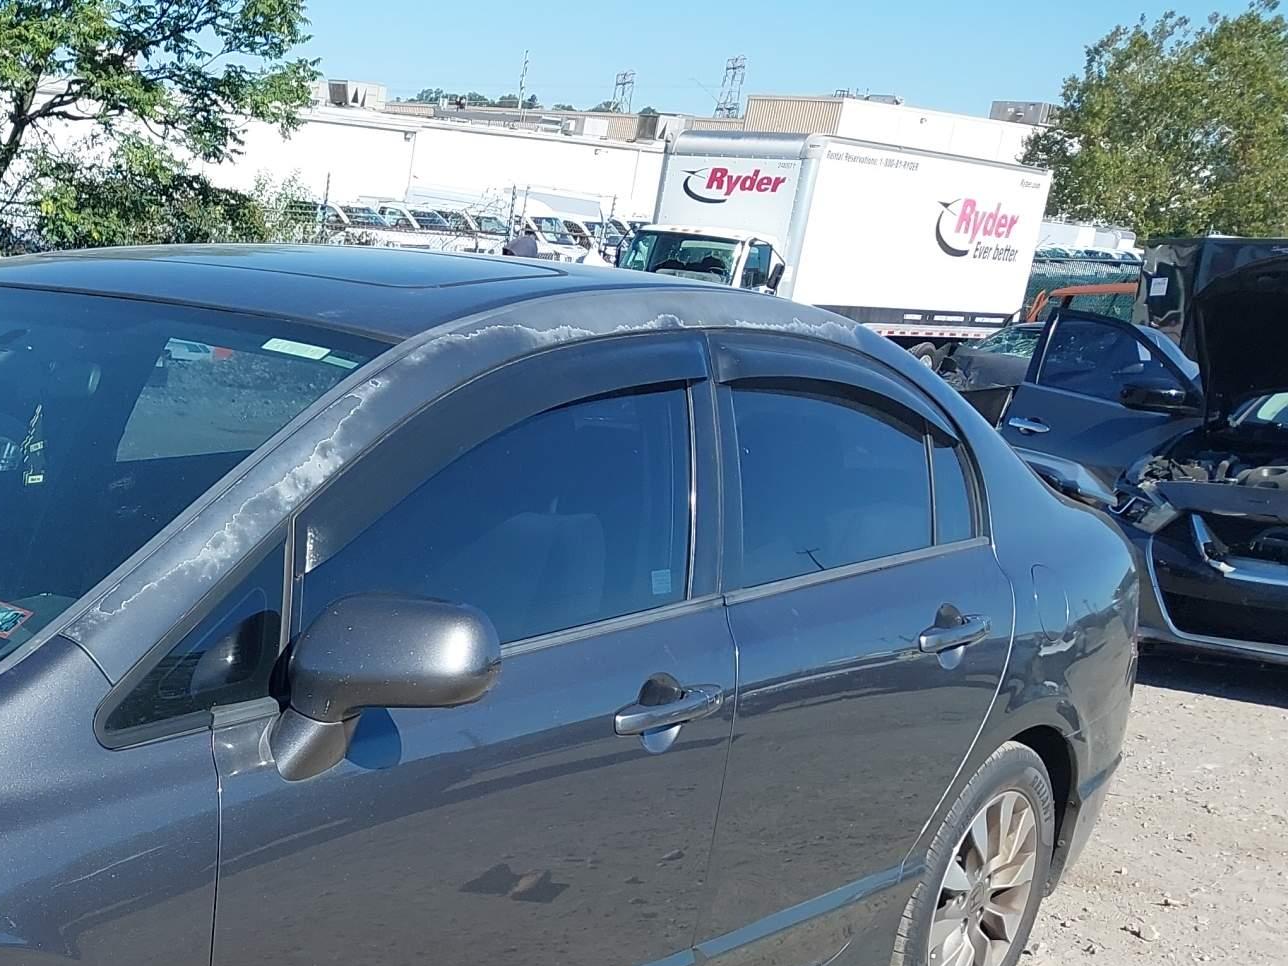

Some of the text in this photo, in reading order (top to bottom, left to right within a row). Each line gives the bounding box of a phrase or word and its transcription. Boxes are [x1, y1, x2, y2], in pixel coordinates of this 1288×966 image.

[706, 167, 787, 196] Ryder
[954, 198, 1020, 244] Ryder
[972, 241, 993, 260] Ever
